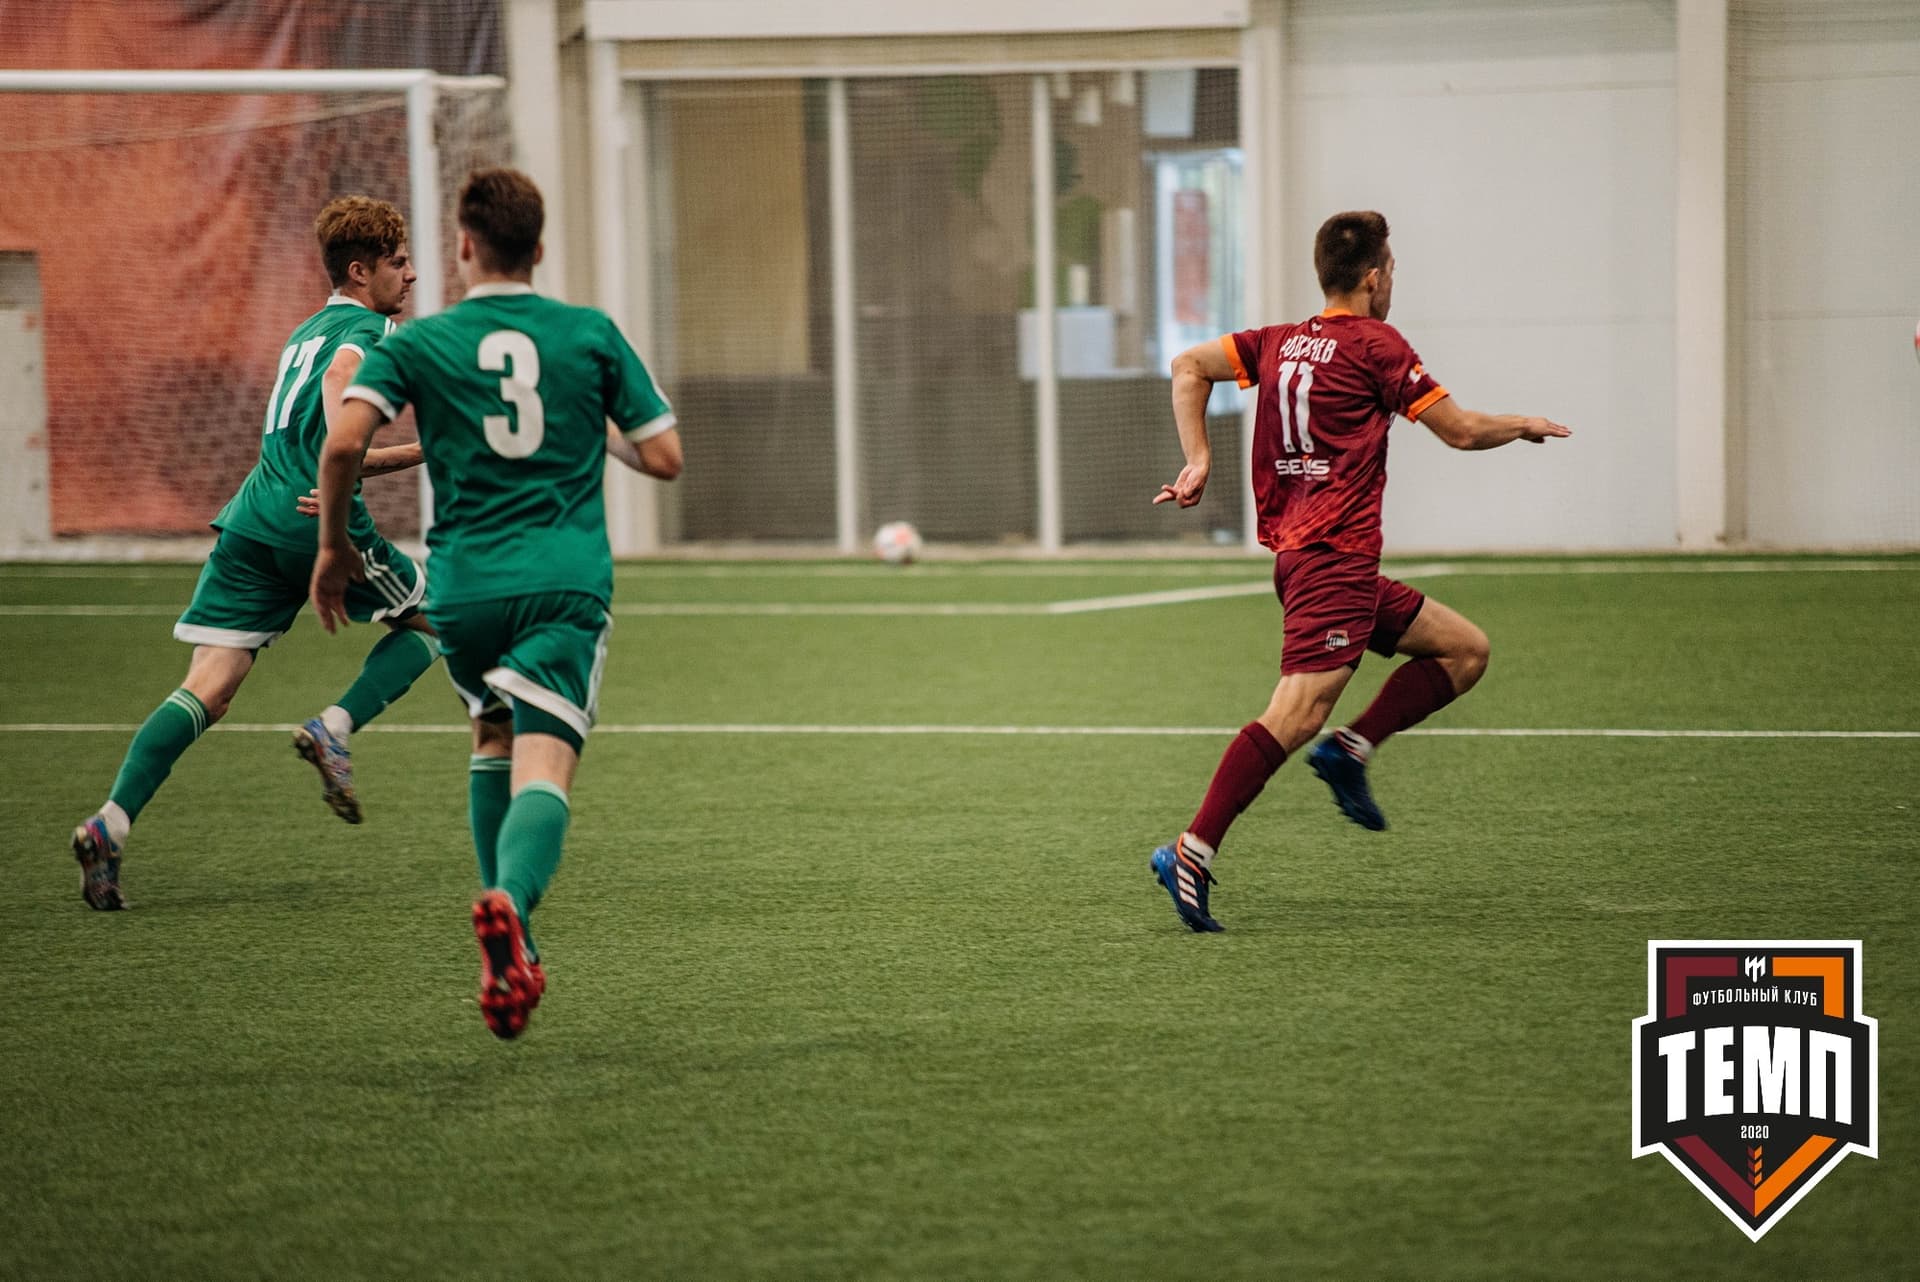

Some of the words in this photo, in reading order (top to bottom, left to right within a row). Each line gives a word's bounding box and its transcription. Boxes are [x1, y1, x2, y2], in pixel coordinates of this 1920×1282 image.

[265, 335, 327, 435] 17
[477, 329, 545, 459] 3
[1278, 361, 1315, 452] 11
